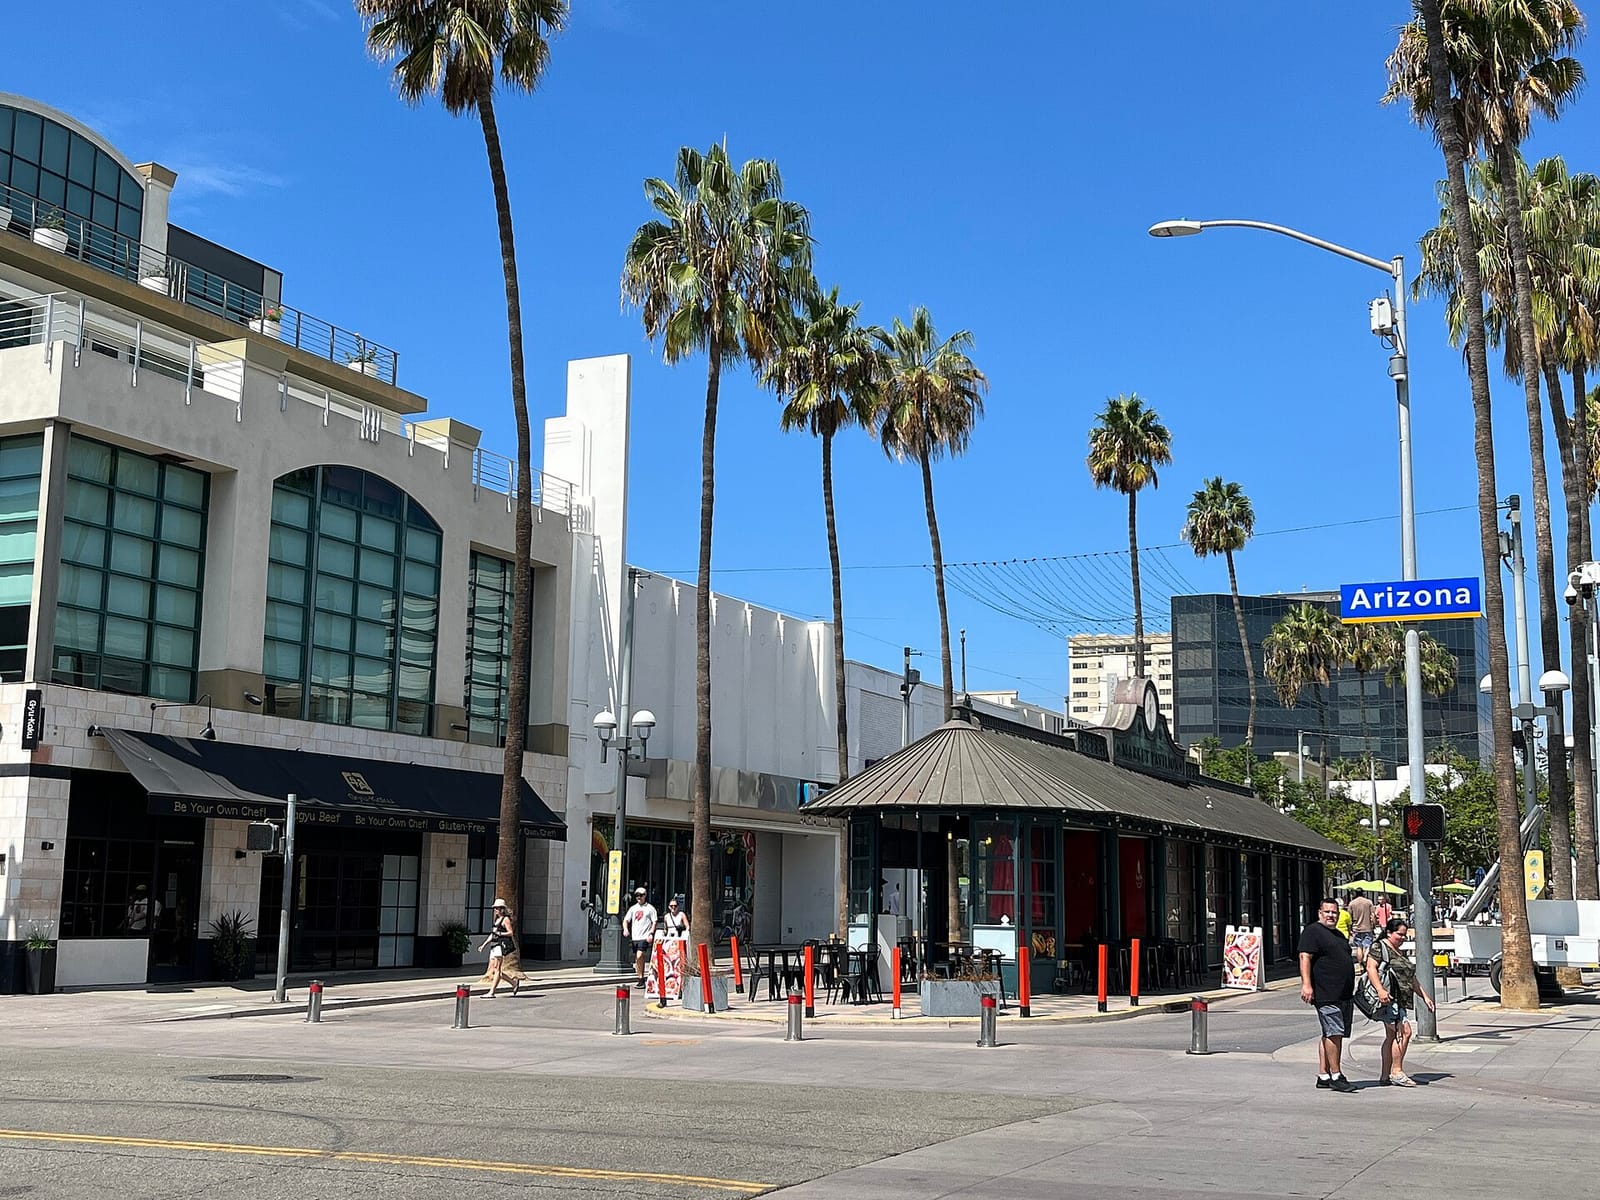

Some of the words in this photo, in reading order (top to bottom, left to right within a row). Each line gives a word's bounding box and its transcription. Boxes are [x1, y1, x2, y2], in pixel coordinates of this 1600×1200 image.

[1350, 586, 1471, 610] Arizona
[173, 801, 187, 812] Be
[189, 802, 214, 814] Your
[216, 804, 238, 815] Own
[241, 806, 267, 818] Chef!
[319, 811, 340, 823] Beef
[355, 814, 366, 825] Be
[367, 815, 387, 827] Your
[388, 816, 407, 828] Own
[408, 818, 429, 830] Chef!
[438, 820, 486, 833] Gluten-Free
